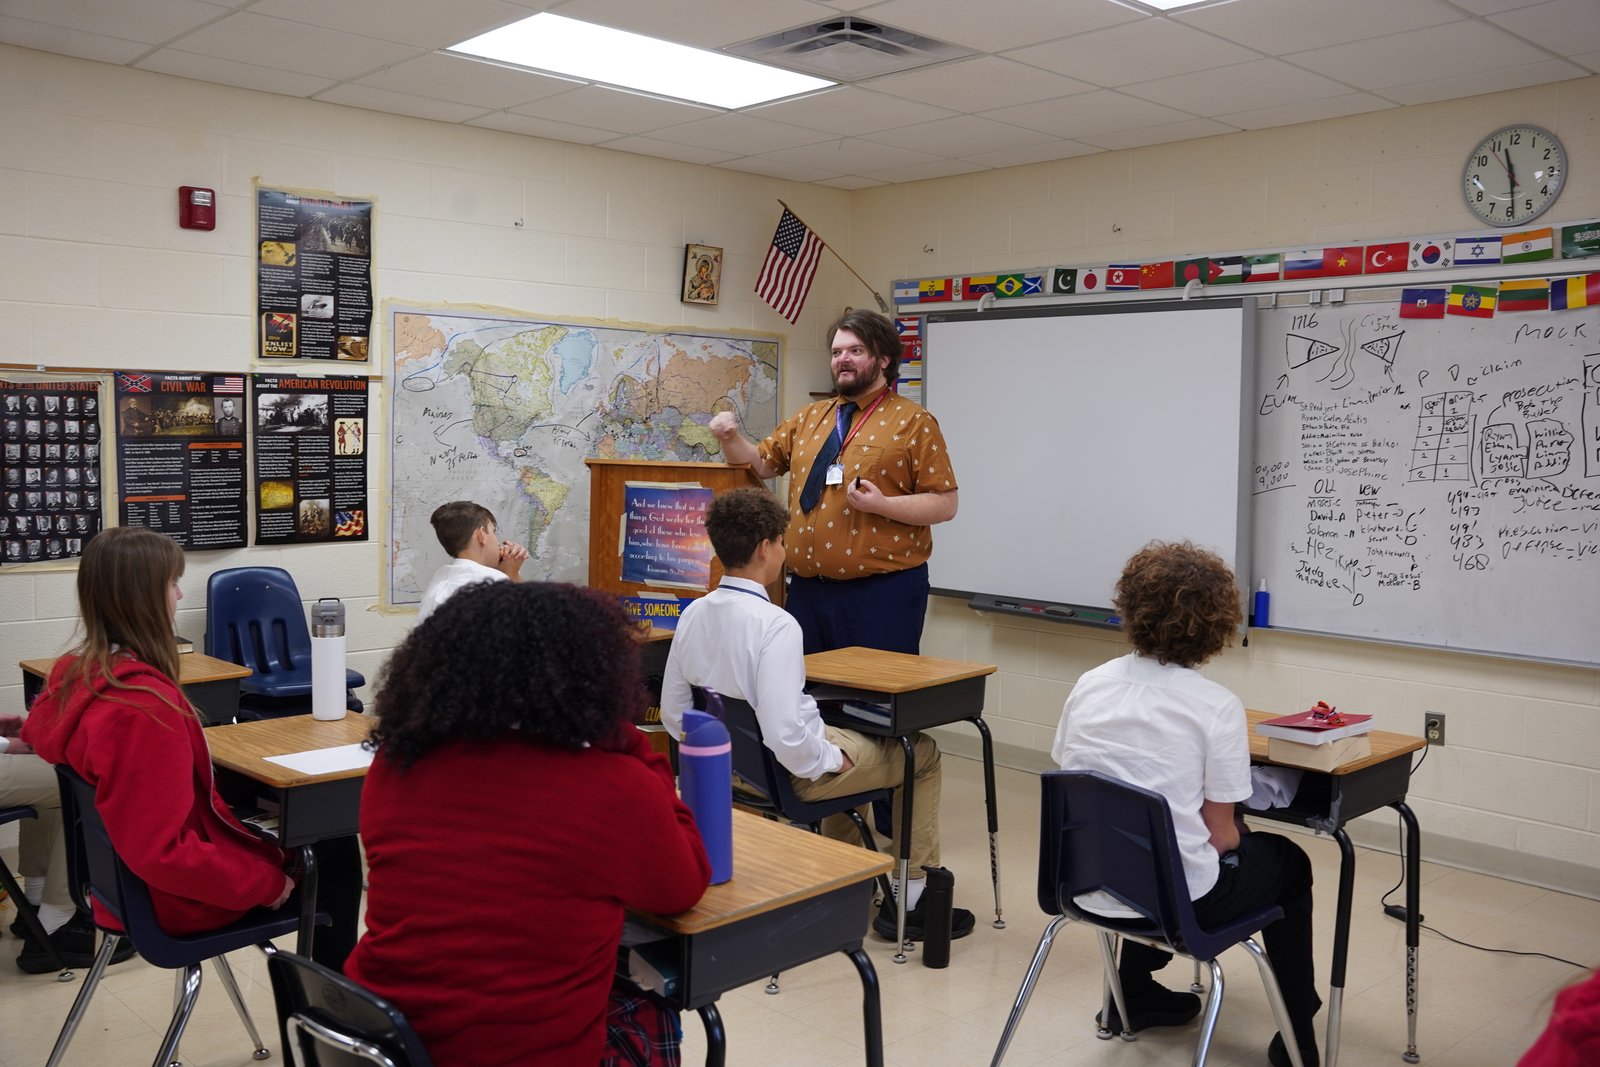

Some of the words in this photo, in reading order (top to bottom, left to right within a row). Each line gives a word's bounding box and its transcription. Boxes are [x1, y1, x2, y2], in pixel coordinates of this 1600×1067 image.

[1510, 134, 1520, 146] 12
[1492, 141, 1501, 152] 11
[1543, 148, 1551, 160] 2
[1478, 155, 1488, 167] 10
[1548, 166, 1555, 178] 3
[1540, 185, 1548, 196] 4
[1476, 191, 1483, 202] 8
[1489, 202, 1496, 214] 7
[1525, 200, 1532, 210] 5
[1506, 206, 1513, 217] 6
[70, 382, 100, 392] STATES
[160, 381, 184, 392] CIVIL
[186, 382, 206, 392] WAR
[279, 379, 318, 389] AMERICAN
[320, 380, 366, 390] REVOLUTION
[632, 498, 646, 508] And
[658, 500, 672, 509] know
[675, 501, 687, 511] that
[697, 502, 706, 512] all
[630, 512, 647, 522] things
[649, 512, 664, 522] God
[666, 515, 683, 523] works
[686, 515, 694, 524] for
[696, 516, 705, 525] the
[633, 525, 647, 535] good
[649, 526, 656, 534] of
[658, 526, 672, 536] those
[675, 528, 687, 536] who
[689, 528, 701, 537] love
[656, 539, 669, 549] have
[672, 540, 686, 550] been
[629, 551, 657, 562] according
[647, 564, 668, 573] Romans
[624, 600, 642, 616] GIVE
[644, 603, 681, 617] SOMEONE
